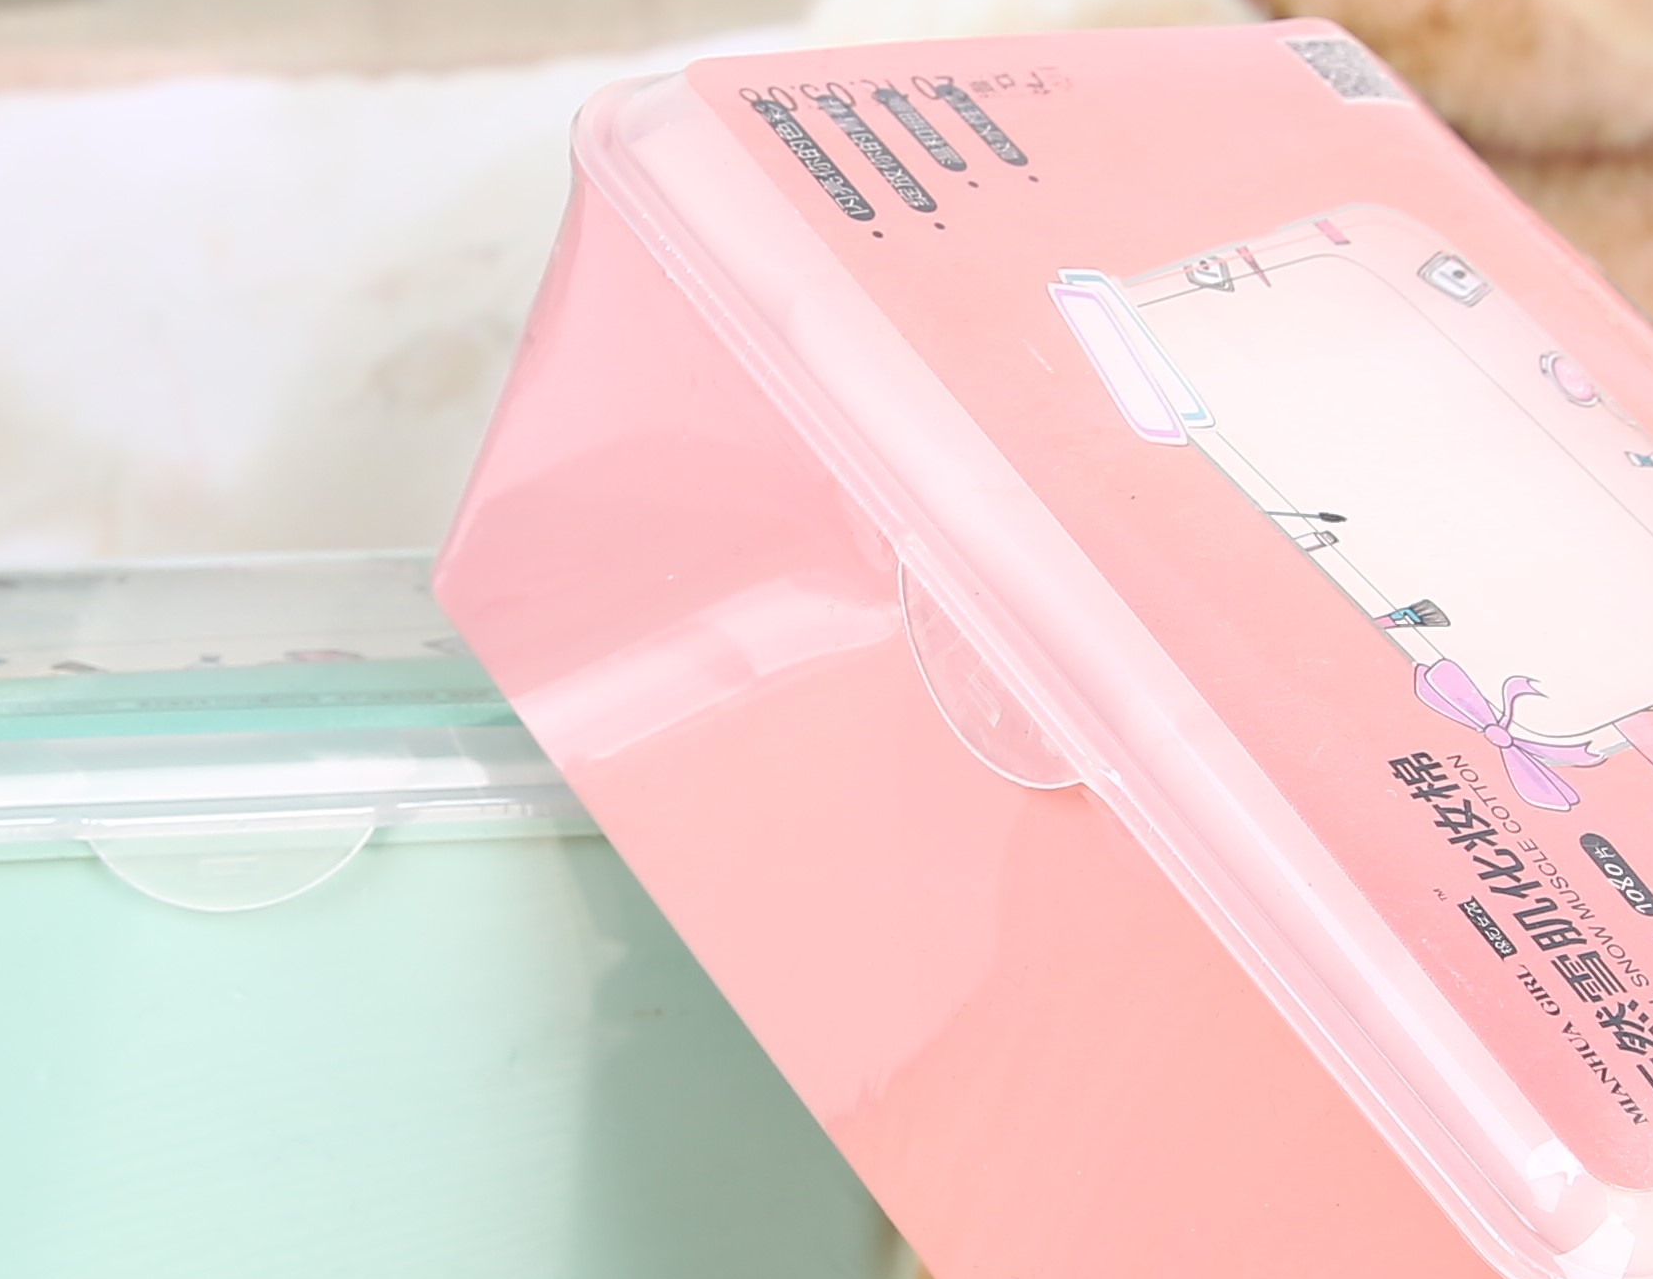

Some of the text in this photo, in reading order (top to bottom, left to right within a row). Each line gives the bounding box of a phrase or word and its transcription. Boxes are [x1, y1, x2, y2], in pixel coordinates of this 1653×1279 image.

[1446, 755, 1522, 833] COTTON
[1517, 839, 1595, 920] MUSCLE
[1588, 926, 1649, 987] SNOW
[1516, 965, 1648, 1125] MIANHUA GIRL
